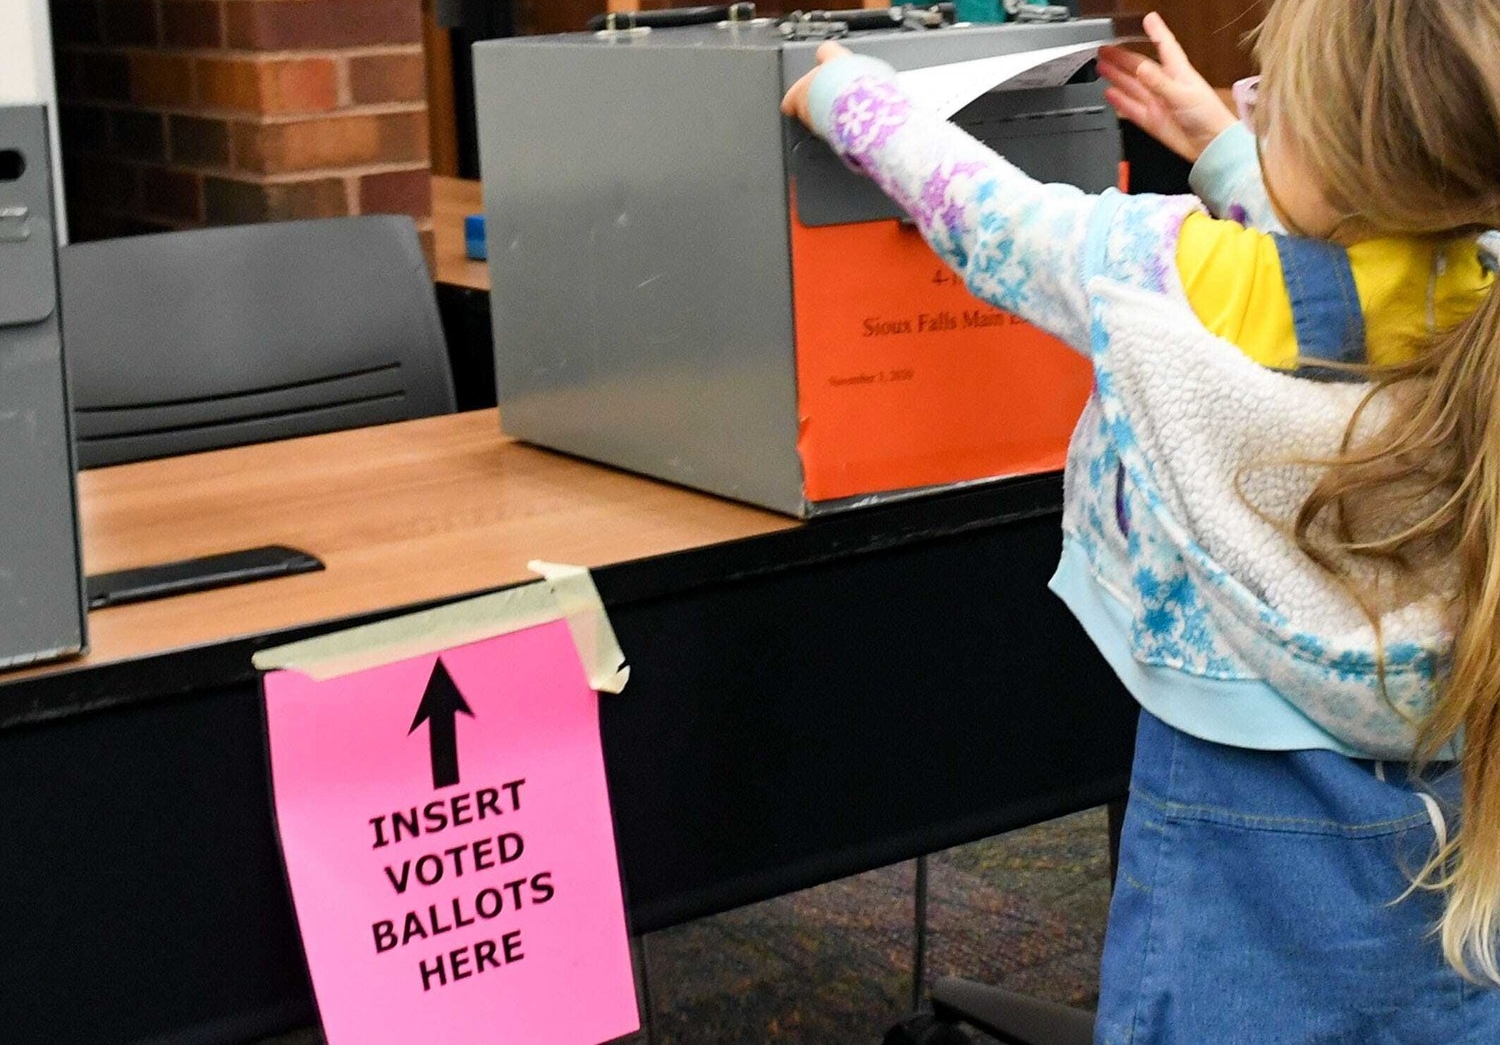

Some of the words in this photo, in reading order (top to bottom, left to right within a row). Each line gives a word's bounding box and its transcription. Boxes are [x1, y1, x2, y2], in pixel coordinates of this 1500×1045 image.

[863, 317, 912, 337] Sioux
[917, 312, 957, 332] Falls
[368, 778, 526, 850] INSERT
[384, 832, 525, 894] VOTED
[371, 871, 555, 954] BALLOTS
[418, 929, 525, 992] HERE
